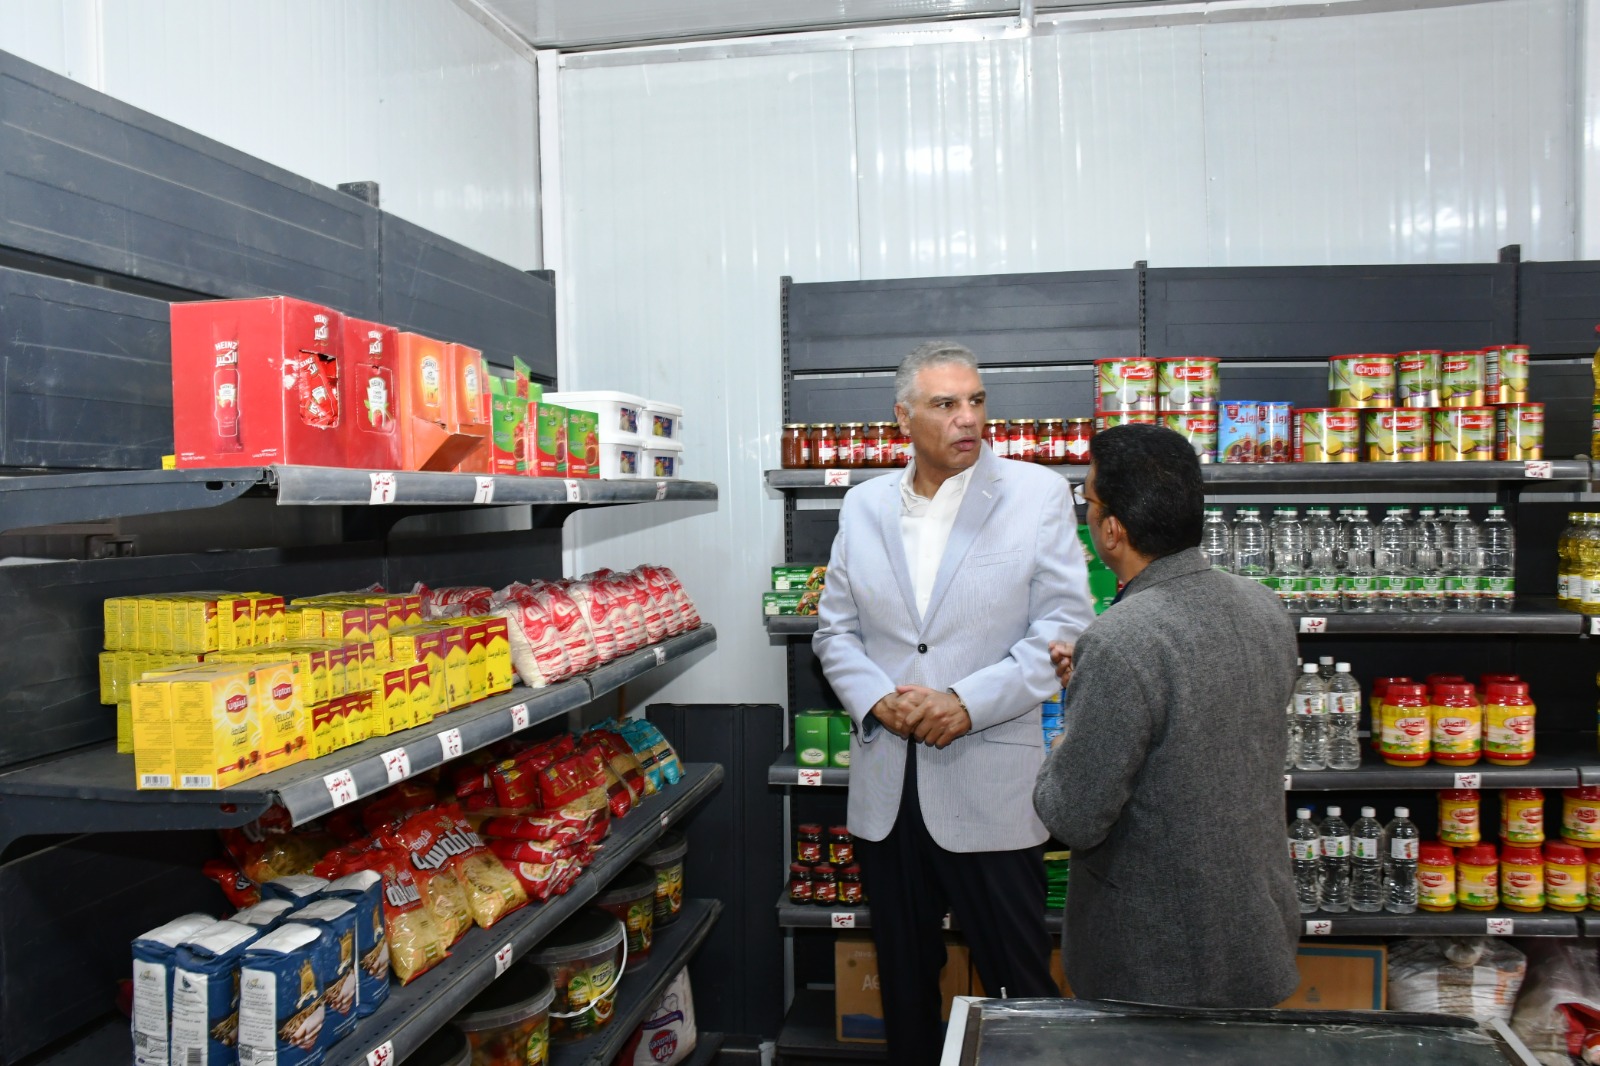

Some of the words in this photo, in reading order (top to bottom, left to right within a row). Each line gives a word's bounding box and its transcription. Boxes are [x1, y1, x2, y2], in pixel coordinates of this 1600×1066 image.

[215, 341, 238, 351] HEINZ
[215, 350, 237, 368] الكبير
[1176, 367, 1211, 378] كريستال
[1356, 364, 1391, 375] Crystal
[1384, 417, 1422, 428] كريستال
[274, 686, 292, 698] Lipton
[274, 710, 295, 724] YELLOW
[277, 722, 295, 733] LABEL
[655, 1045, 674, 1060] POP
